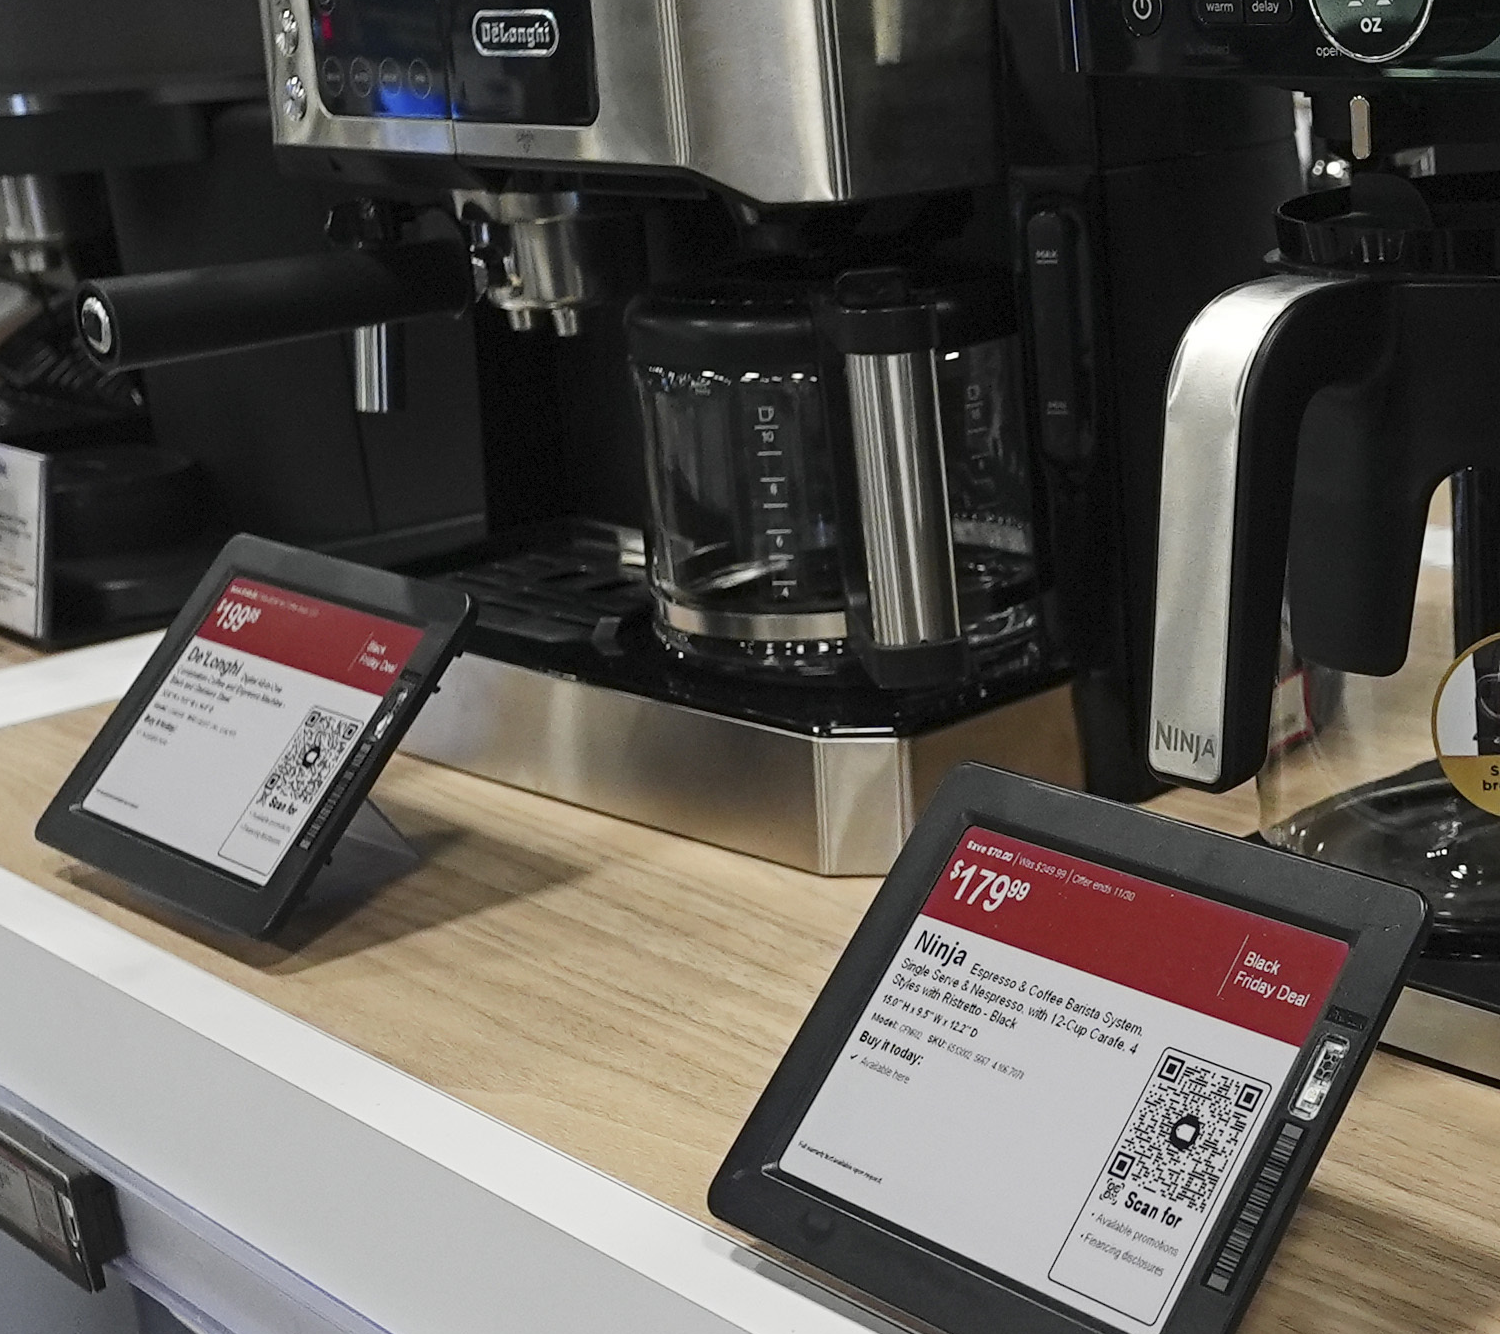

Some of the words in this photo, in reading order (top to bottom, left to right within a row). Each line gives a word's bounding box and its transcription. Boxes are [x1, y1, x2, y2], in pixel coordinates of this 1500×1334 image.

[1206, 1, 1234, 13] warm
[1252, 0, 1280, 14] delay
[1360, 18, 1382, 33] OZ
[1154, 719, 1216, 764] NINJA
[967, 840, 987, 855] Save
[1072, 874, 1093, 890] Offer
[1093, 881, 1112, 895] ends
[1113, 886, 1136, 903] 11/30
[914, 930, 968, 967] Ninja
[970, 963, 1017, 990] Espresso
[1018, 980, 1027, 994] &
[1029, 984, 1064, 1007] Coffee
[1065, 997, 1100, 1020] Barista
[1244, 951, 1281, 975] Black
[892, 973, 921, 995] Styles
[922, 984, 941, 1002] with
[941, 992, 982, 1017] Ristretto
[989, 1012, 1019, 1031] Black
[901, 957, 930, 978] Single
[931, 969, 959, 989] Serve
[961, 979, 969, 992] &
[1028, 1006, 1048, 1022] with
[1050, 1013, 1087, 1038] 12-Cup
[1130, 1043, 1140, 1055] 4
[1233, 970, 1277, 999] Friday
[1276, 985, 1311, 1008] Deal
[902, 1002, 912, 1013] H
[934, 1012, 944, 1025] W
[971, 1027, 979, 1038] D
[859, 1030, 882, 1051] Buy
[881, 1037, 890, 1052] it
[890, 1043, 925, 1066] today:
[859, 1056, 893, 1078] Available
[892, 1068, 910, 1085] here
[1124, 1191, 1159, 1220] Scan
[1160, 1207, 1183, 1228] for
[1096, 1213, 1133, 1238] Available
[1132, 1230, 1179, 1257] promotions
[1083, 1232, 1122, 1260] Financing
[1121, 1249, 1164, 1277] disclosures
